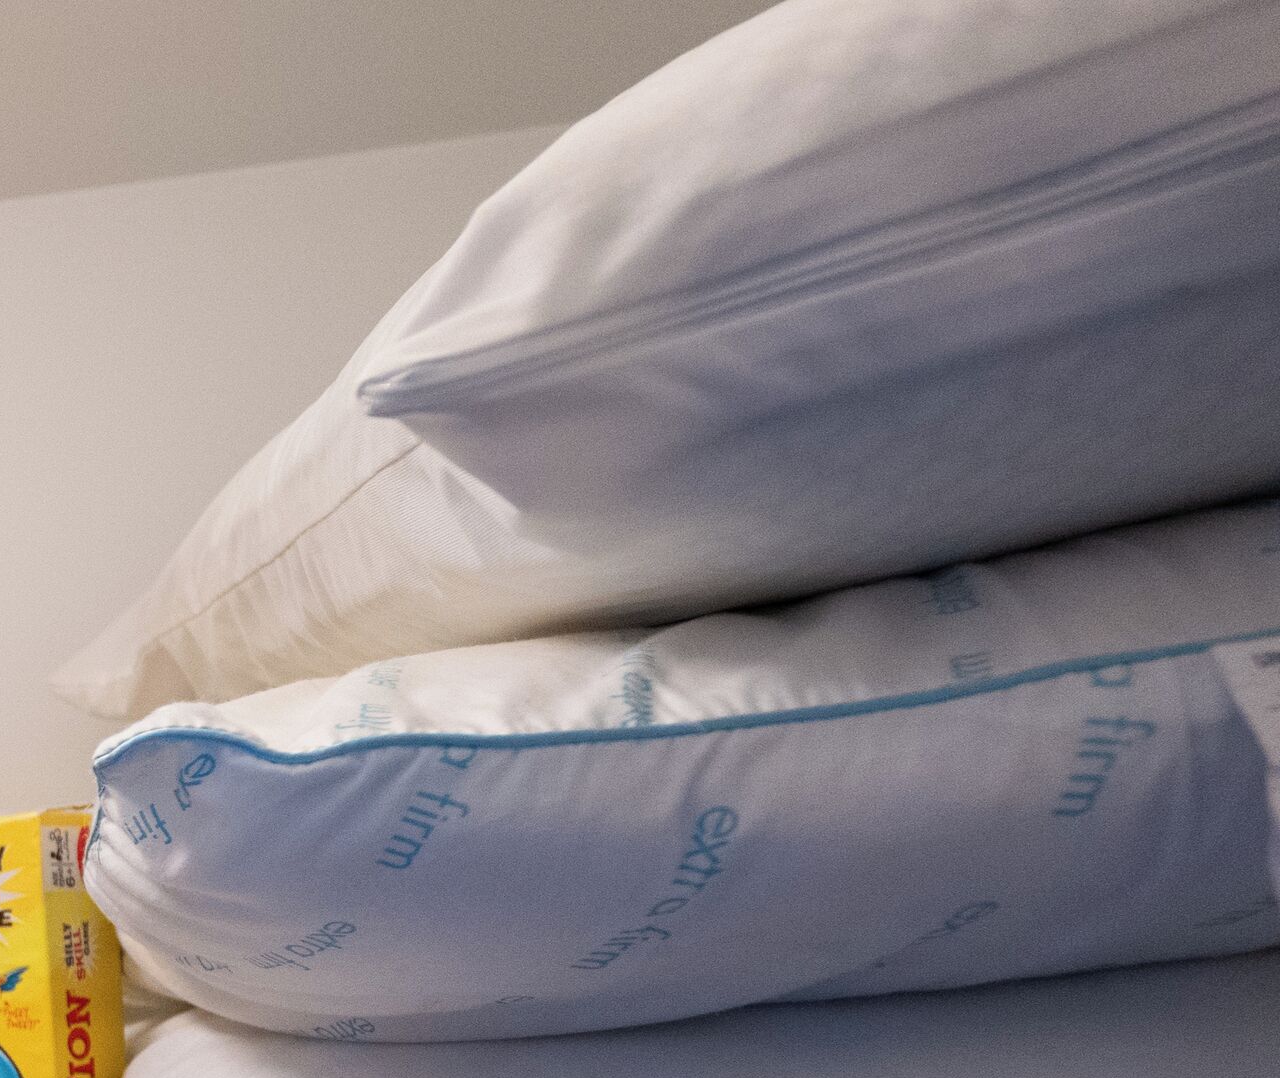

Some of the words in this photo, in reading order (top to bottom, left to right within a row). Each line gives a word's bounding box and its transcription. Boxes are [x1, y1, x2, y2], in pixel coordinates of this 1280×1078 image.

[1051, 717, 1157, 818] firm
[377, 790, 471, 871] firm
[645, 805, 739, 917] extra
[63, 921, 75, 968] SILLY
[72, 927, 87, 982] SKILL
[285, 920, 357, 960] extra
[569, 925, 673, 970] firm
